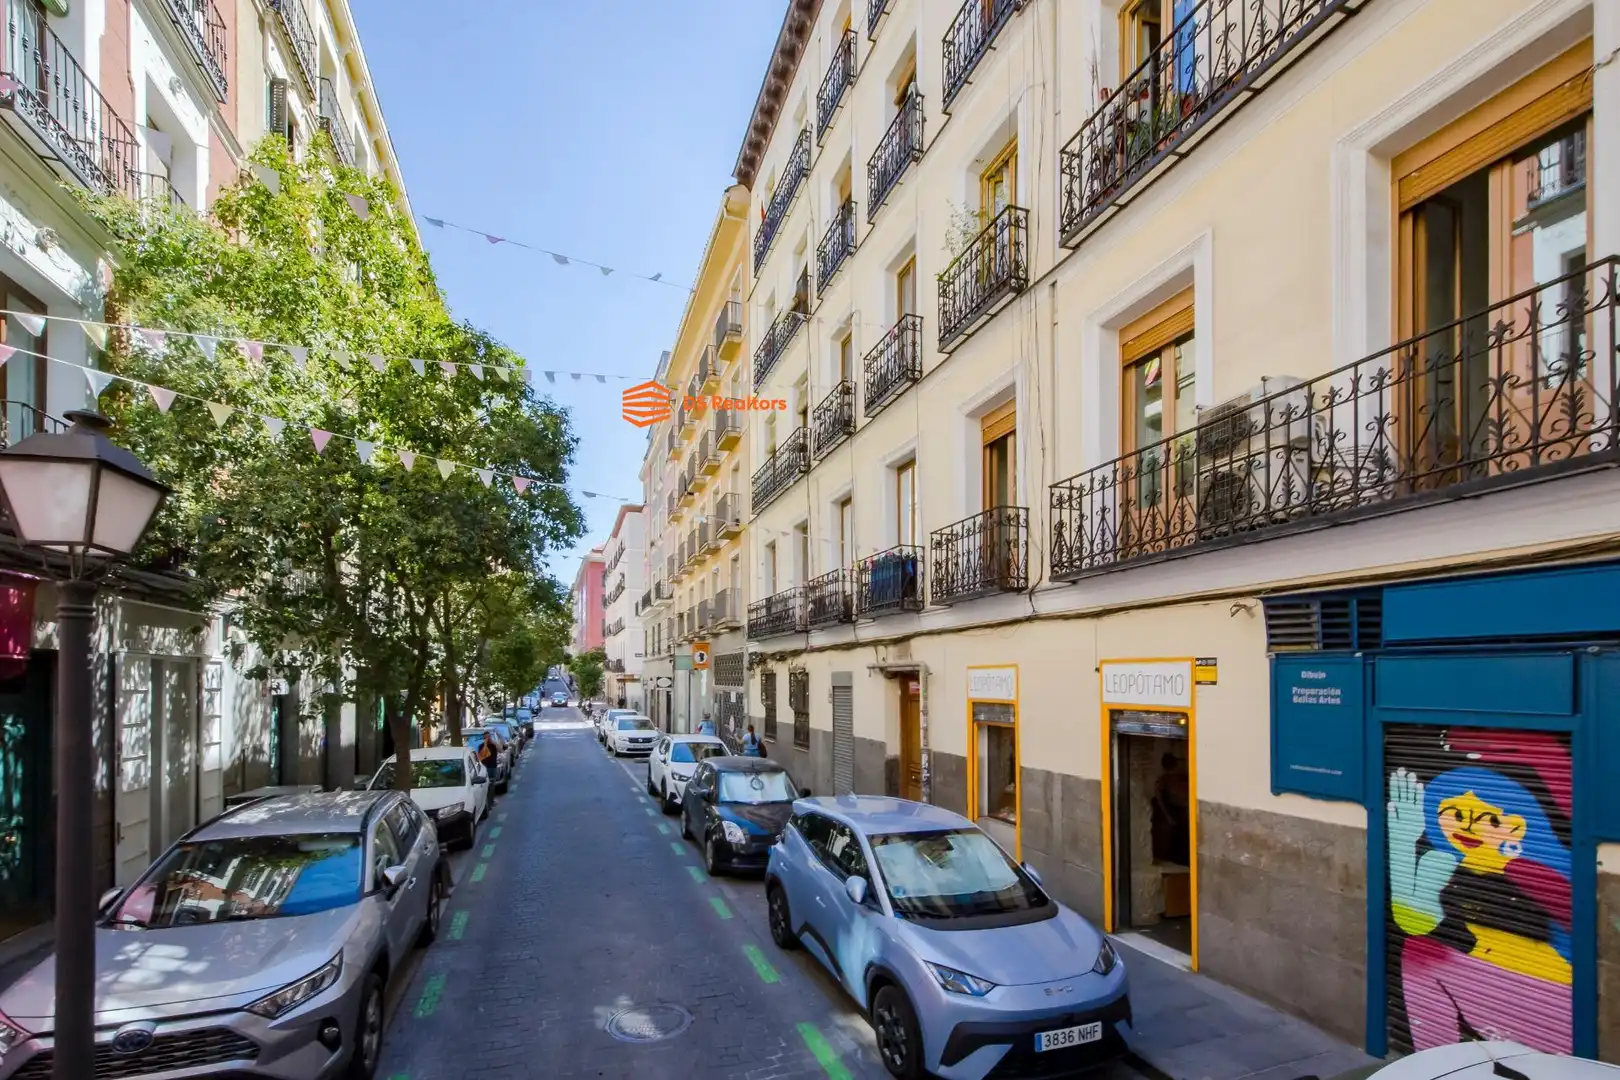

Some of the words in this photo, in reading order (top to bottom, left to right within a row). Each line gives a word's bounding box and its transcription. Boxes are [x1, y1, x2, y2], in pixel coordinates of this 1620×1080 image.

[1301, 670, 1326, 679] Dibujo
[1105, 671, 1184, 696] LEOPÓTAMO
[1292, 686, 1341, 696] Preparación
[1293, 695, 1317, 704] Bellas
[1318, 696, 1341, 704] Artes
[1044, 1030, 1075, 1048] 3836
[1078, 1024, 1099, 1042] NHF
